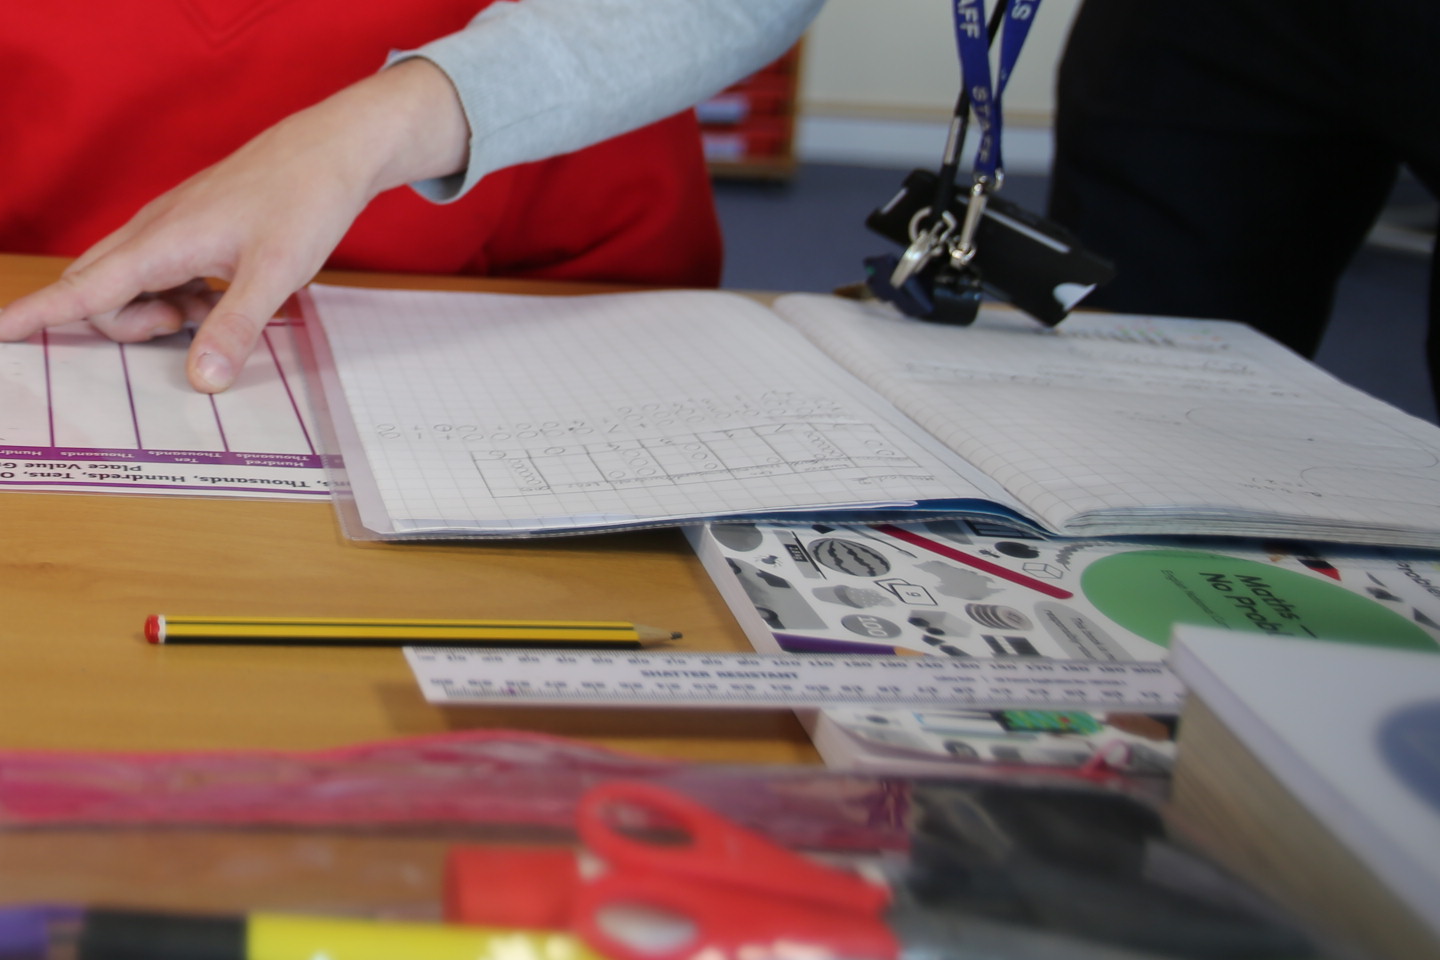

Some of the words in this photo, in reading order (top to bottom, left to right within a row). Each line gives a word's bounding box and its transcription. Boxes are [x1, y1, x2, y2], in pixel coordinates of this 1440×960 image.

[60, 451, 136, 459] Thousands
[148, 450, 223, 459] Thousands
[235, 453, 310, 461] Thousands
[24, 461, 82, 471] Value
[87, 463, 142, 472] Place
[245, 459, 305, 467] Hundred
[23, 470, 75, 480] Tens,
[82, 471, 186, 483] Hundreds,
[193, 475, 311, 489] Thousands,
[1198, 572, 1234, 592] No
[1233, 573, 1301, 621] Maths
[858, 614, 889, 638] 100
